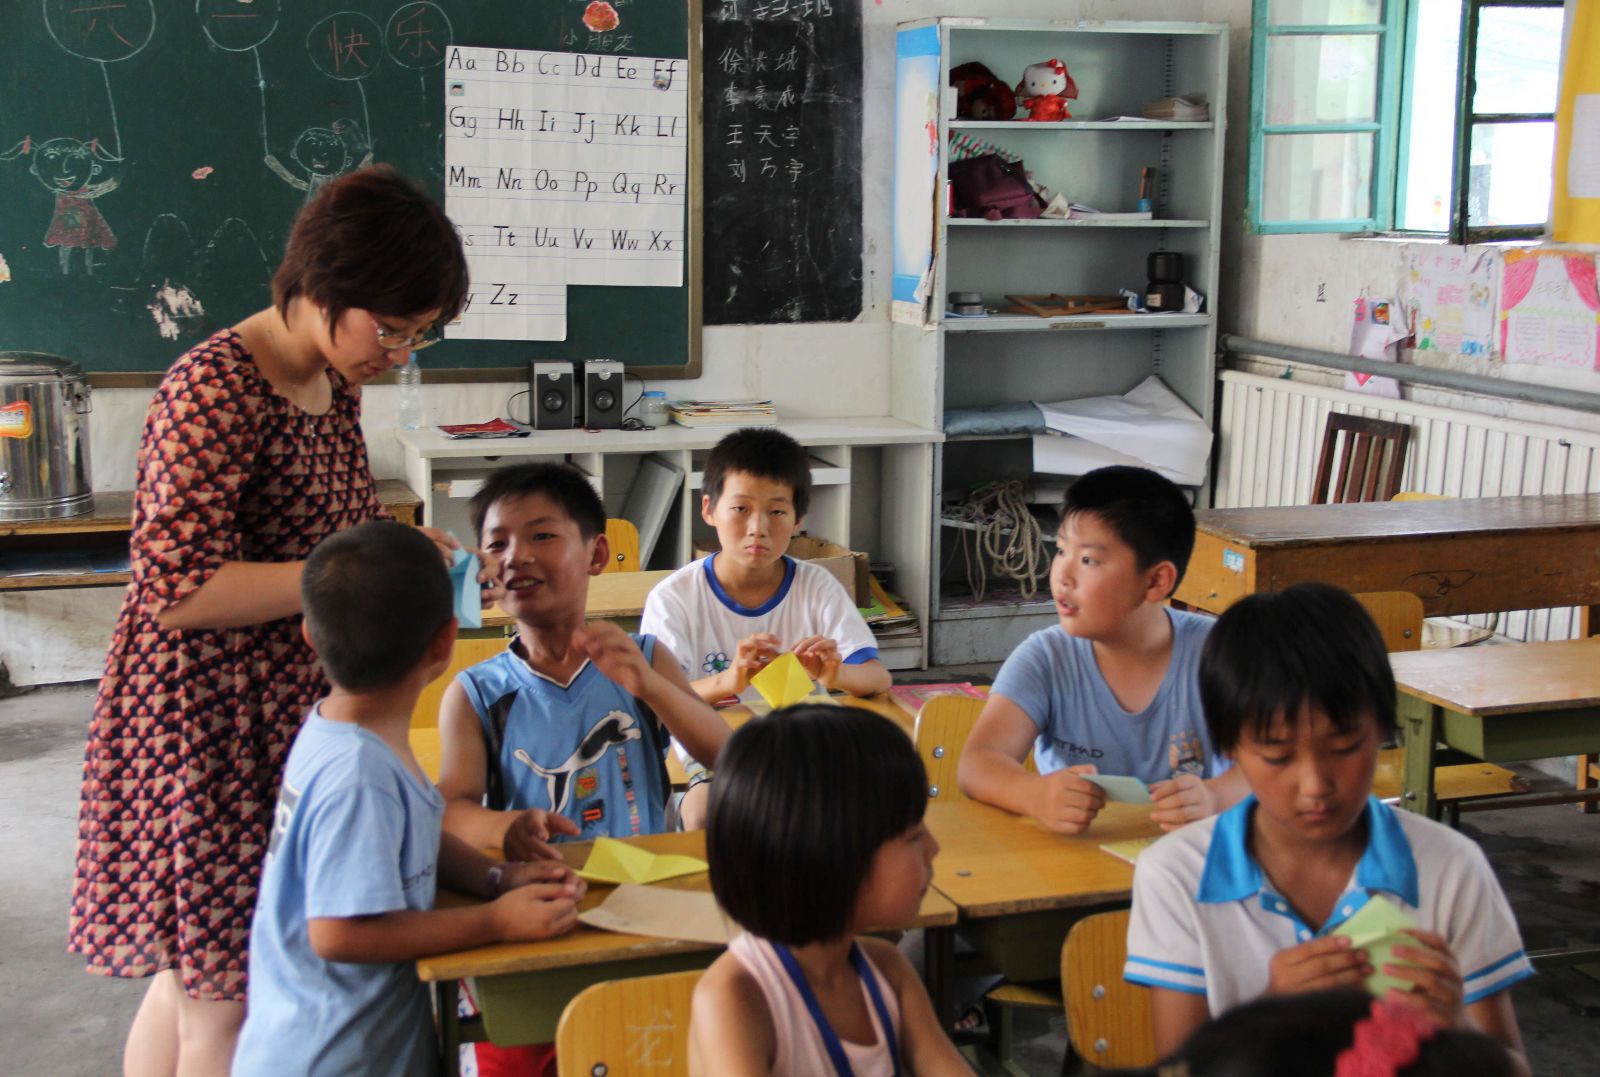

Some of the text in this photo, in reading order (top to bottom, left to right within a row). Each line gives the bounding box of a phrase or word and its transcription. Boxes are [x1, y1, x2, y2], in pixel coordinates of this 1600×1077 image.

[448, 47, 478, 71] Aa
[495, 50, 526, 73] Bb
[537, 52, 561, 77] Cc
[574, 54, 601, 78] Dd
[616, 57, 638, 80] Ee
[449, 105, 678, 144] Gg Hh Ii Jj Kk Ll
[449, 165, 678, 204] Mm Nn Oo Pp Qq Rr
[492, 225, 517, 248] Tt
[534, 227, 560, 249] Uu
[572, 228, 594, 250] Vv
[610, 229, 639, 251] Ww
[648, 230, 673, 252] Xx
[490, 283, 519, 306] Zz
